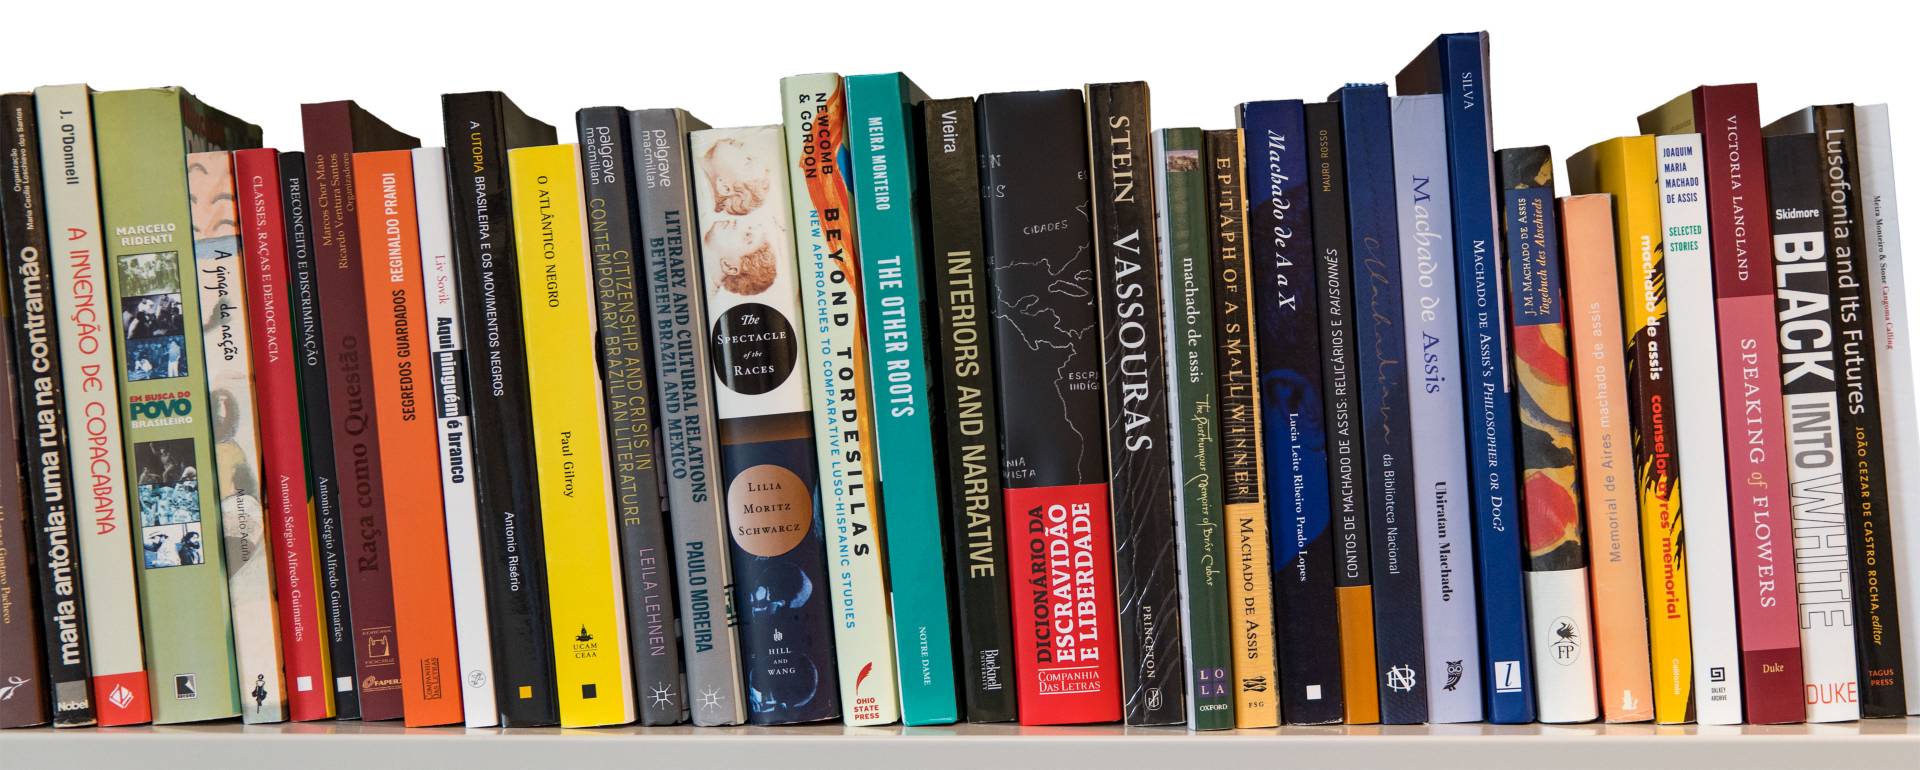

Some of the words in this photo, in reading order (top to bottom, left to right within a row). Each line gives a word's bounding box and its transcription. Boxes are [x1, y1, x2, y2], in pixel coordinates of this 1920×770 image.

[799, 94, 810, 104] &
[1461, 72, 1474, 109] SILVA
[59, 110, 73, 120] J.
[816, 92, 833, 175] NEWCOMB
[868, 116, 885, 151] MEIRA
[941, 111, 959, 153] Vieira
[61, 124, 79, 185] O'Donnell
[586, 128, 601, 185] macmillan
[596, 126, 616, 184] palgrave
[800, 110, 817, 179] GORDON
[1109, 115, 1135, 204] STEIN
[1320, 129, 1329, 158] ROSSO
[1663, 146, 1693, 158] JOAQUIM
[1727, 115, 1741, 190] VICTORIA
[537, 175, 548, 185] O
[872, 155, 891, 211] MONTEIRO
[1268, 130, 1291, 220] Machado
[1321, 161, 1331, 192] MAURO
[1664, 163, 1688, 173] MARIA
[1665, 177, 1699, 188] MACHADO
[1826, 129, 1853, 239] Lusofonia
[382, 172, 398, 215] PRANDI
[1217, 157, 1237, 261] EPITAPH
[1667, 195, 1676, 204] DE
[1677, 193, 1698, 203] ASSIS
[116, 223, 176, 236] MARCELO
[538, 189, 555, 260] ATLÂNTICO
[1413, 175, 1442, 288] Machado
[1532, 198, 1545, 247] Abschieds
[1669, 225, 1702, 237] SELECTED
[1775, 208, 1819, 220] Skidmore
[67, 228, 88, 241] A
[121, 234, 172, 247] RIDENTI
[386, 218, 403, 283] REGINALDO
[1274, 227, 1293, 248] de
[1670, 241, 1699, 252] STORIES
[1731, 196, 1749, 281] LANGLAND
[214, 249, 233, 261] A
[289, 177, 307, 259] PRECONCEITO
[298, 271, 318, 366] DISCRIMINAÇÃO
[877, 255, 903, 290] THE
[1275, 252, 1294, 268] A
[1473, 240, 1486, 307] MACHADO
[1539, 251, 1547, 265] des
[1641, 235, 1656, 313] machado
[1836, 247, 1859, 289] and
[202, 265, 230, 298] ginga
[545, 264, 560, 308] NEGRO
[1184, 258, 1200, 325] machado
[1222, 268, 1238, 293] OF
[1277, 274, 1289, 287] a
[1535, 267, 1551, 315] Tagebuch
[20, 247, 50, 373] contramão
[69, 250, 101, 355] INVENÇÃO
[219, 303, 237, 320] da
[741, 314, 761, 326] The
[948, 250, 980, 377] INTERIORS
[1225, 301, 1239, 315] A
[1278, 291, 1296, 311] X
[1420, 296, 1440, 322] de
[1478, 312, 1488, 329] DE
[1774, 231, 1835, 386] BLACK
[1841, 295, 1862, 323] Its
[217, 324, 238, 362] nação
[392, 289, 410, 358] GUARDADOS
[437, 317, 454, 350] Aqui
[717, 331, 787, 345] SPECTACLE
[881, 296, 909, 353] OTHER
[1113, 229, 1153, 452] VASSOURAS
[1188, 329, 1202, 347] de
[1647, 316, 1661, 337] de
[734, 365, 775, 377] RACES
[743, 351, 751, 359] of
[1189, 350, 1203, 384] assis
[1225, 323, 1244, 399] SMALL
[1423, 331, 1446, 394] Assis
[1648, 341, 1663, 381] assis
[1843, 330, 1865, 415] Futures
[35, 378, 53, 407] na
[81, 364, 103, 393] DE
[398, 361, 416, 421] SEGREDOS
[439, 352, 460, 417] ninguém
[824, 207, 849, 327] BEYOND
[837, 346, 870, 557] TORDESILLAS
[887, 358, 914, 418] ROOTS
[130, 399, 192, 421] POVO
[957, 385, 985, 436] AND
[1741, 339, 1764, 464] SPEAKING
[37, 410, 57, 447] rua
[131, 417, 193, 429] BRASILEIRO
[447, 420, 463, 429] é
[1483, 382, 1498, 468] PHILOSOPHER
[1651, 395, 1670, 475] counselor
[1791, 402, 1834, 469] INTO
[447, 431, 465, 484] branco
[560, 431, 571, 457] Paul
[1231, 405, 1250, 496] WINNER
[41, 451, 62, 503] uma
[84, 402, 116, 535] COPACABANA
[563, 461, 576, 498] Gilroy
[1489, 473, 1499, 491] OR
[1748, 472, 1768, 489] of
[743, 504, 792, 515] MORITZ
[961, 444, 995, 578] NARRATIVE
[1028, 505, 1045, 534] DA
[1435, 482, 1447, 538] Ubiratan
[1657, 479, 1671, 529] ayres
[504, 512, 515, 553] Antonio
[738, 524, 801, 536] SCHWARCZ
[44, 507, 73, 595] antônia:
[685, 541, 707, 586] PAULO
[1240, 518, 1254, 592] MACHADO
[1753, 496, 1776, 608] FLOWERS
[1791, 472, 1852, 629] WHITE
[508, 555, 521, 592] Risério
[1045, 504, 1076, 662] ESCRAVIDÃO
[1072, 503, 1098, 641] LIBERDADE
[1440, 542, 1453, 602] Machado
[1661, 538, 1681, 620] memorial
[690, 588, 714, 653] MOREIRA
[1029, 539, 1052, 663] DICIONÁRIO
[1244, 597, 1256, 616] DE
[53, 601, 80, 665] maria
[919, 626, 929, 657] NOTRE
[1143, 606, 1155, 678] PRINCETON
[1246, 620, 1258, 660] ASSIS
[767, 668, 796, 676] WANG
[921, 660, 931, 686] DAME
[1080, 647, 1099, 661] E
[1763, 663, 1784, 673] Duke
[1869, 669, 1894, 677] TAGUS
[57, 700, 88, 712] Nobel
[1199, 703, 1228, 711] OXFORD
[1807, 682, 1857, 704] DUKE
